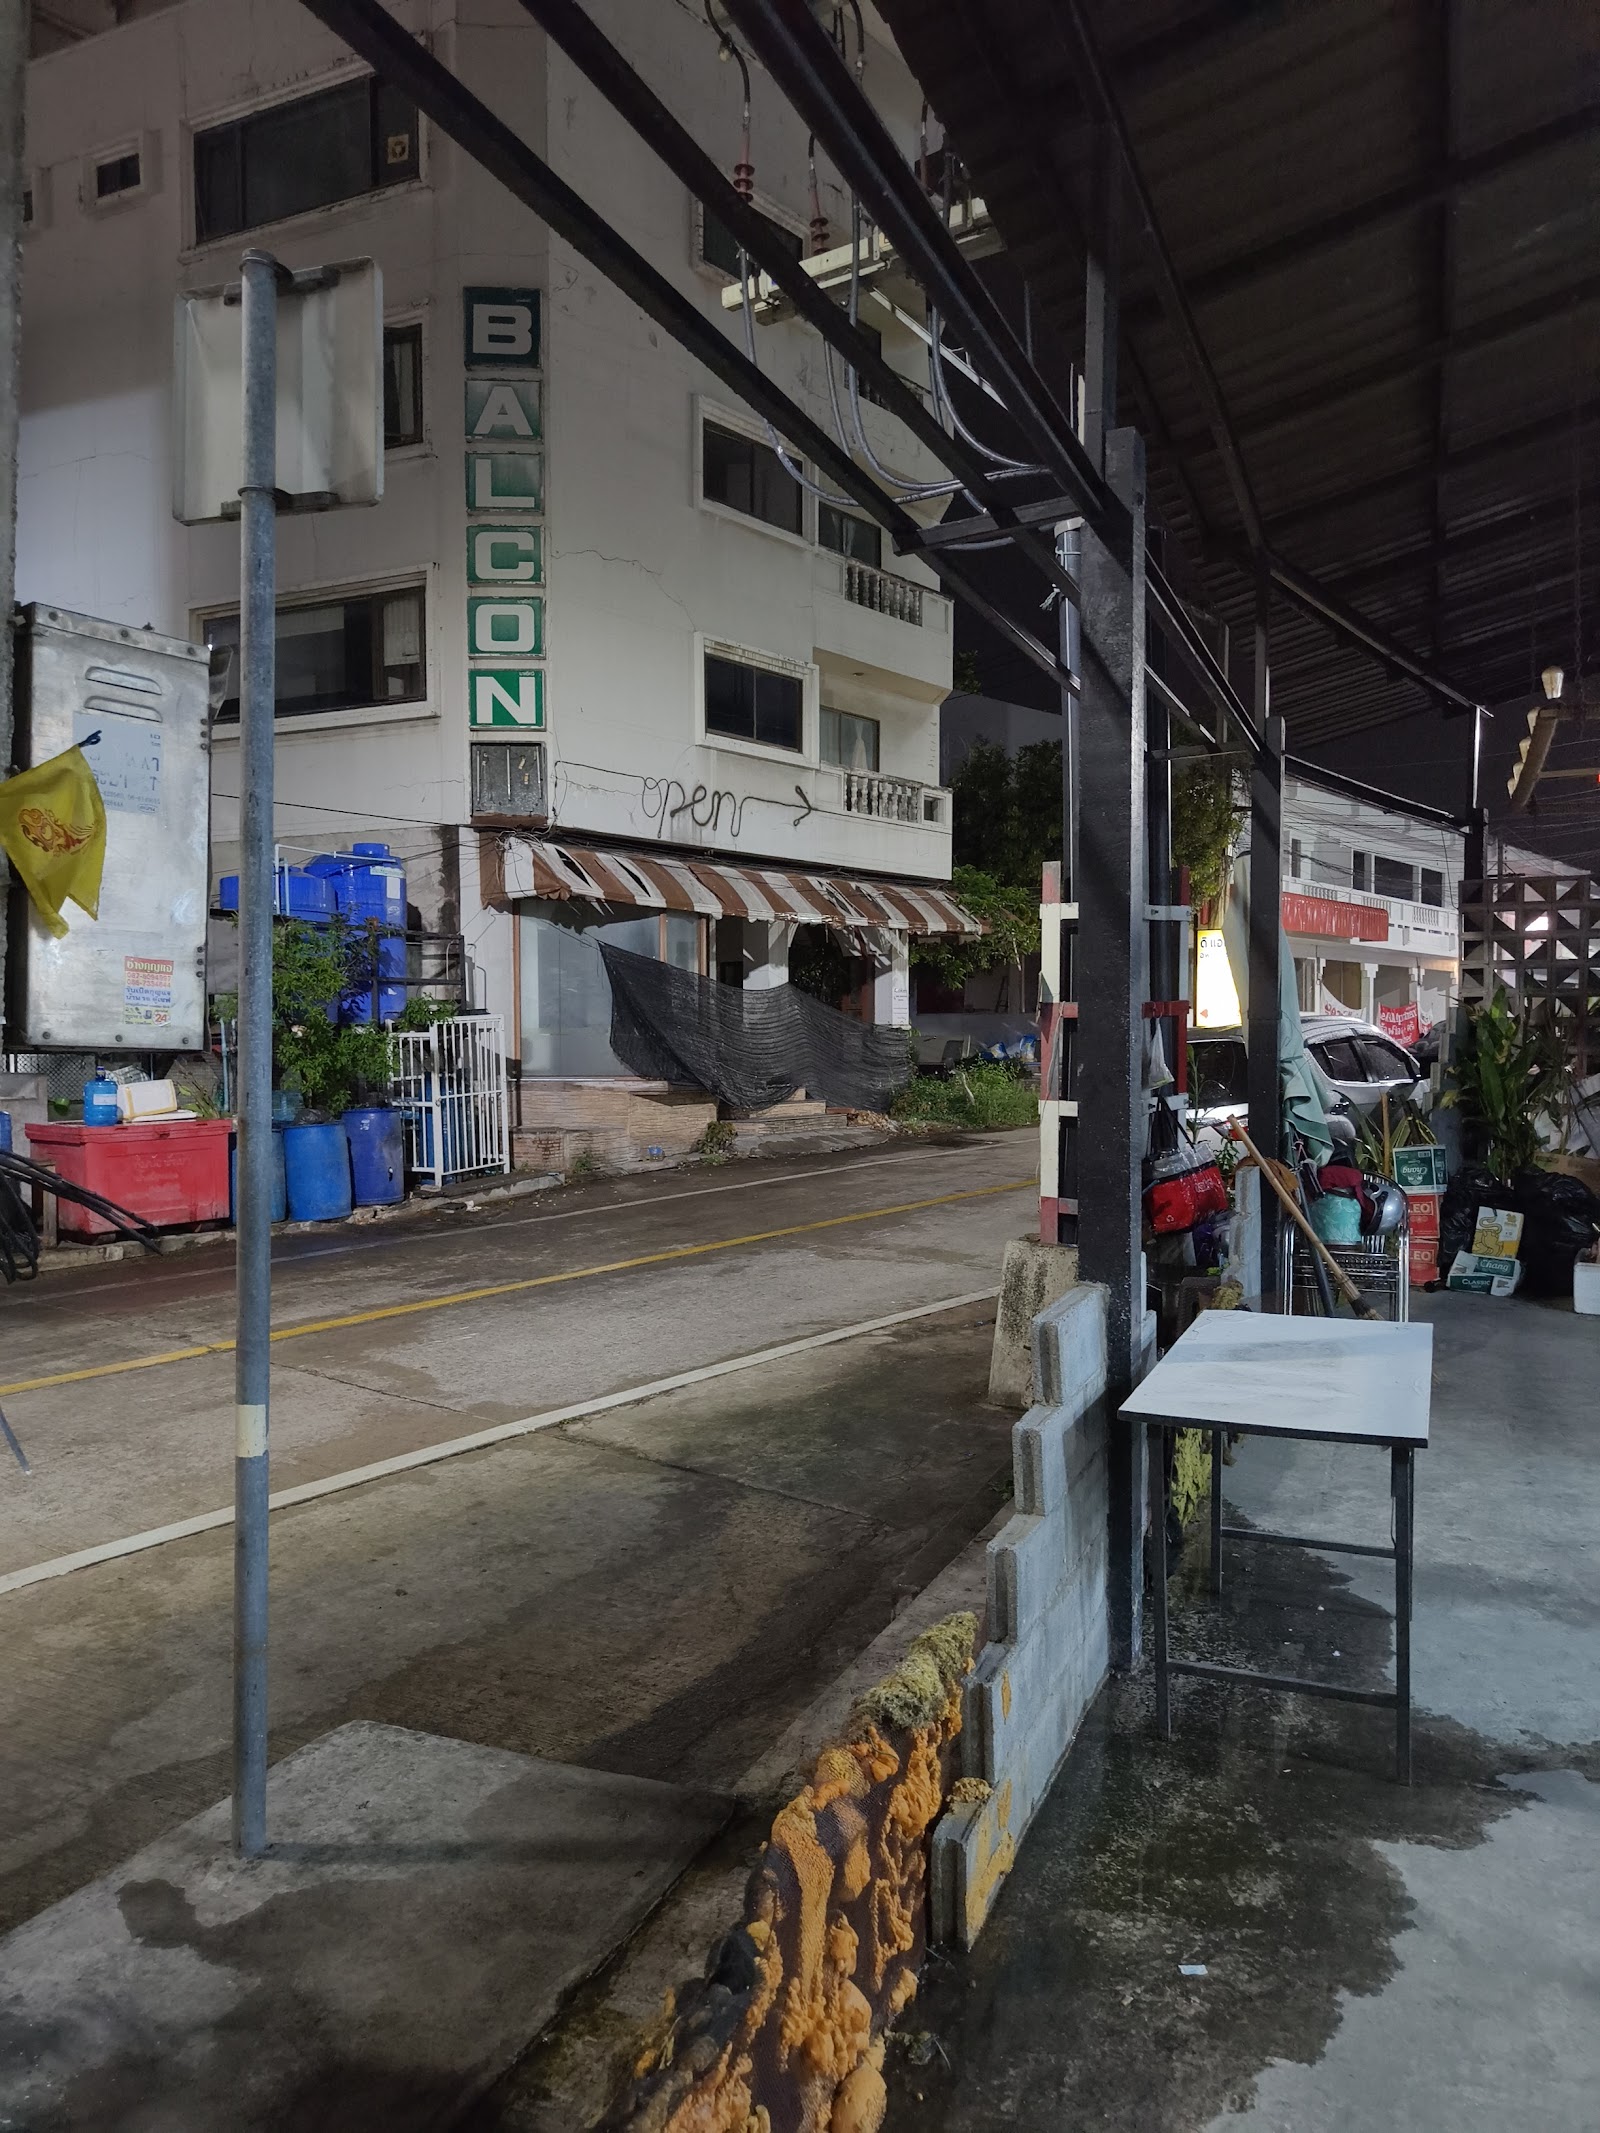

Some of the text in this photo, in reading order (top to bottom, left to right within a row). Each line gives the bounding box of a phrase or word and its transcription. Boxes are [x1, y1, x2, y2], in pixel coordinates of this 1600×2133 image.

[472, 303, 536, 724] BALCON
[641, 777, 742, 838] open
[127, 958, 172, 973] ช่างกุญแจ
[155, 1013, 167, 1023] 24
[1402, 1165, 1428, 1177] Chang
[1410, 1203, 1431, 1214] EO
[1411, 1251, 1432, 1262] EO
[1480, 1260, 1509, 1272] Chang
